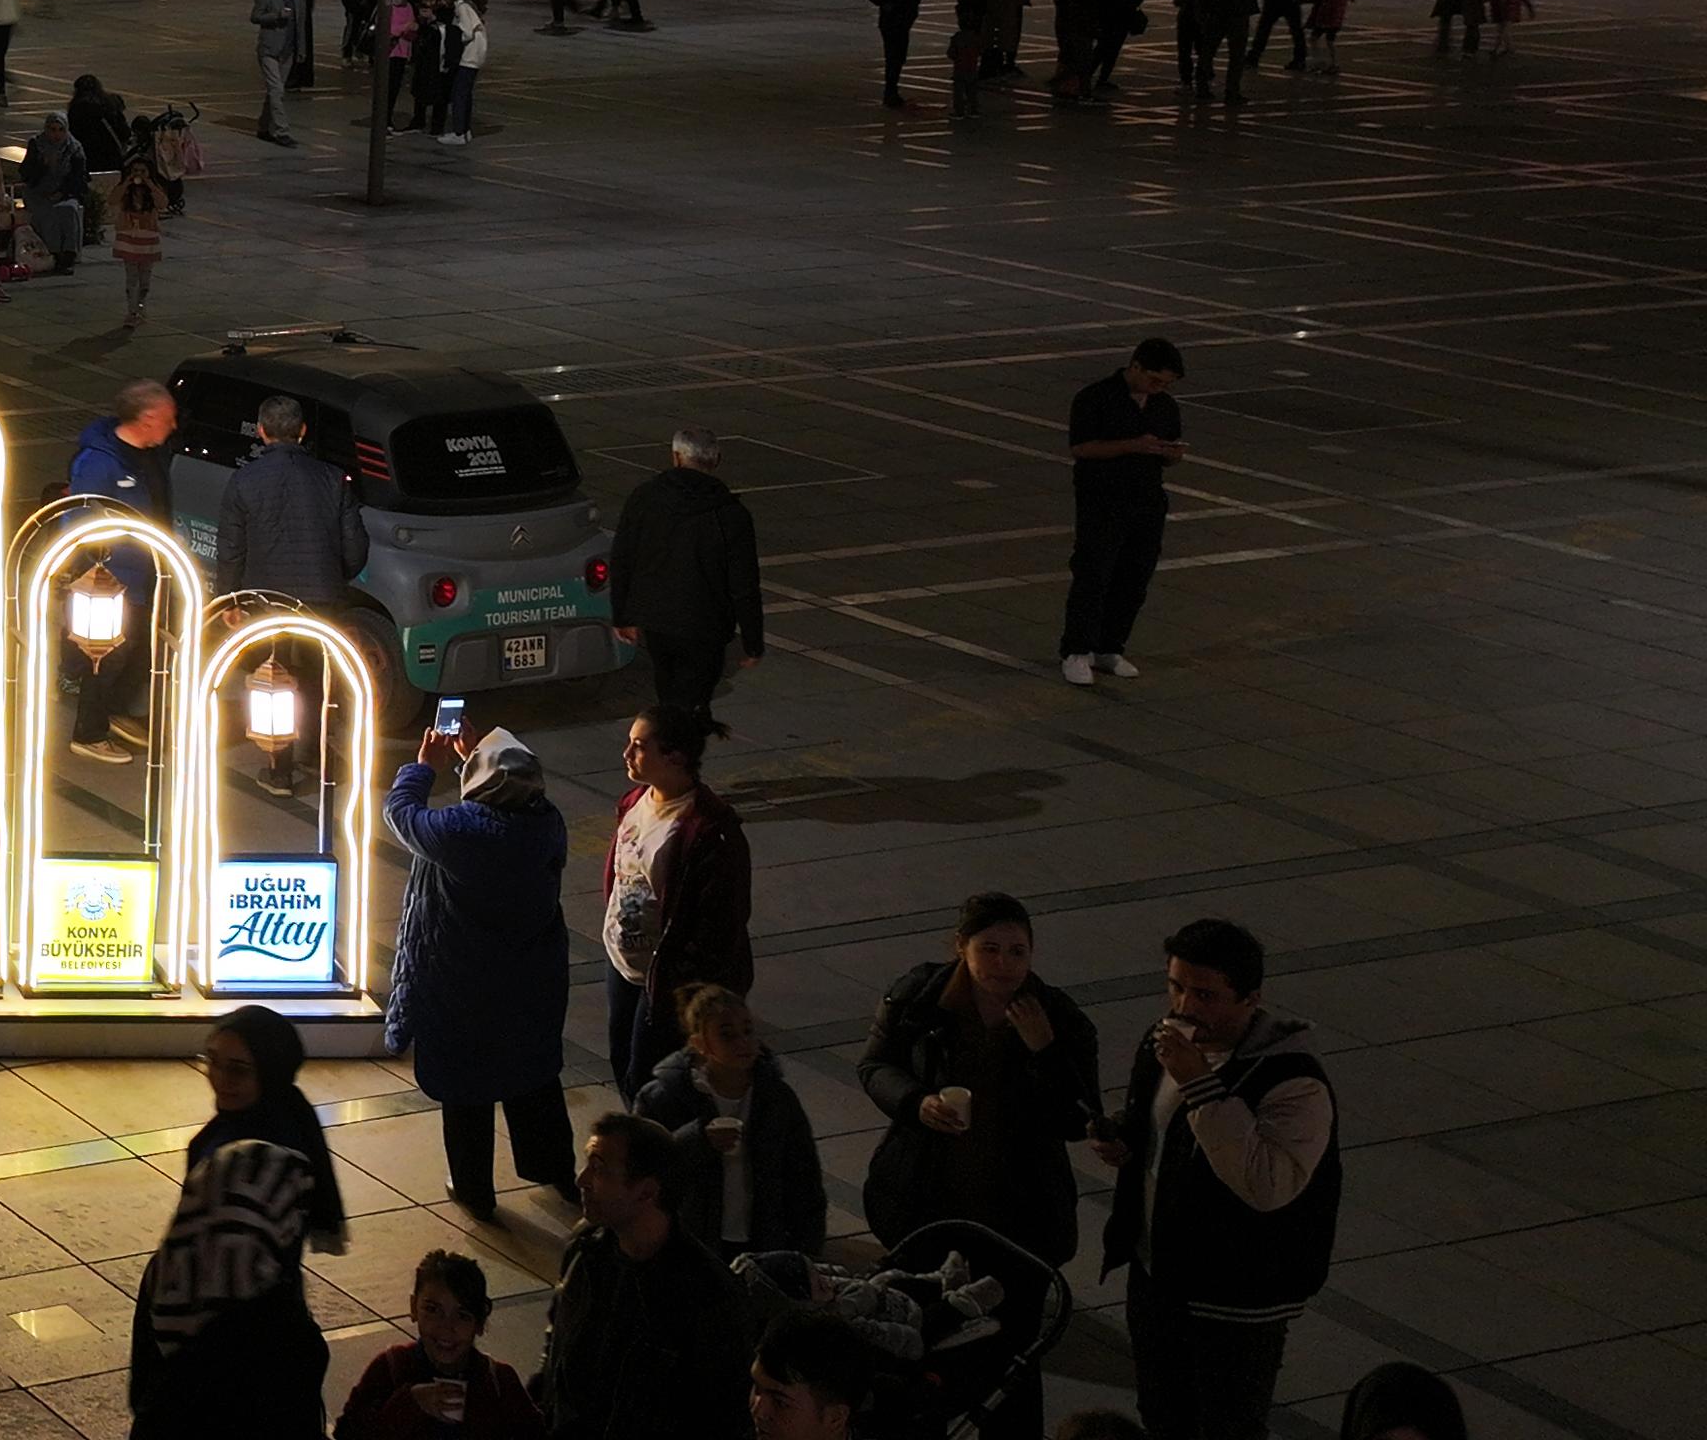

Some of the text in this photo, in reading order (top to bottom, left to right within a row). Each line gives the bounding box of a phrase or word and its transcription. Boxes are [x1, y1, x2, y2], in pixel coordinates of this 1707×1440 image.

[445, 435, 498, 453] KONYA
[467, 449, 503, 467] 2021
[497, 585, 564, 604] MUNICIPAL
[485, 604, 577, 626] TOURISM TEAM
[513, 654, 536, 667] 683
[244, 872, 306, 892] UĞUR
[67, 926, 118, 939] KONYA
[217, 910, 329, 962] Altay
